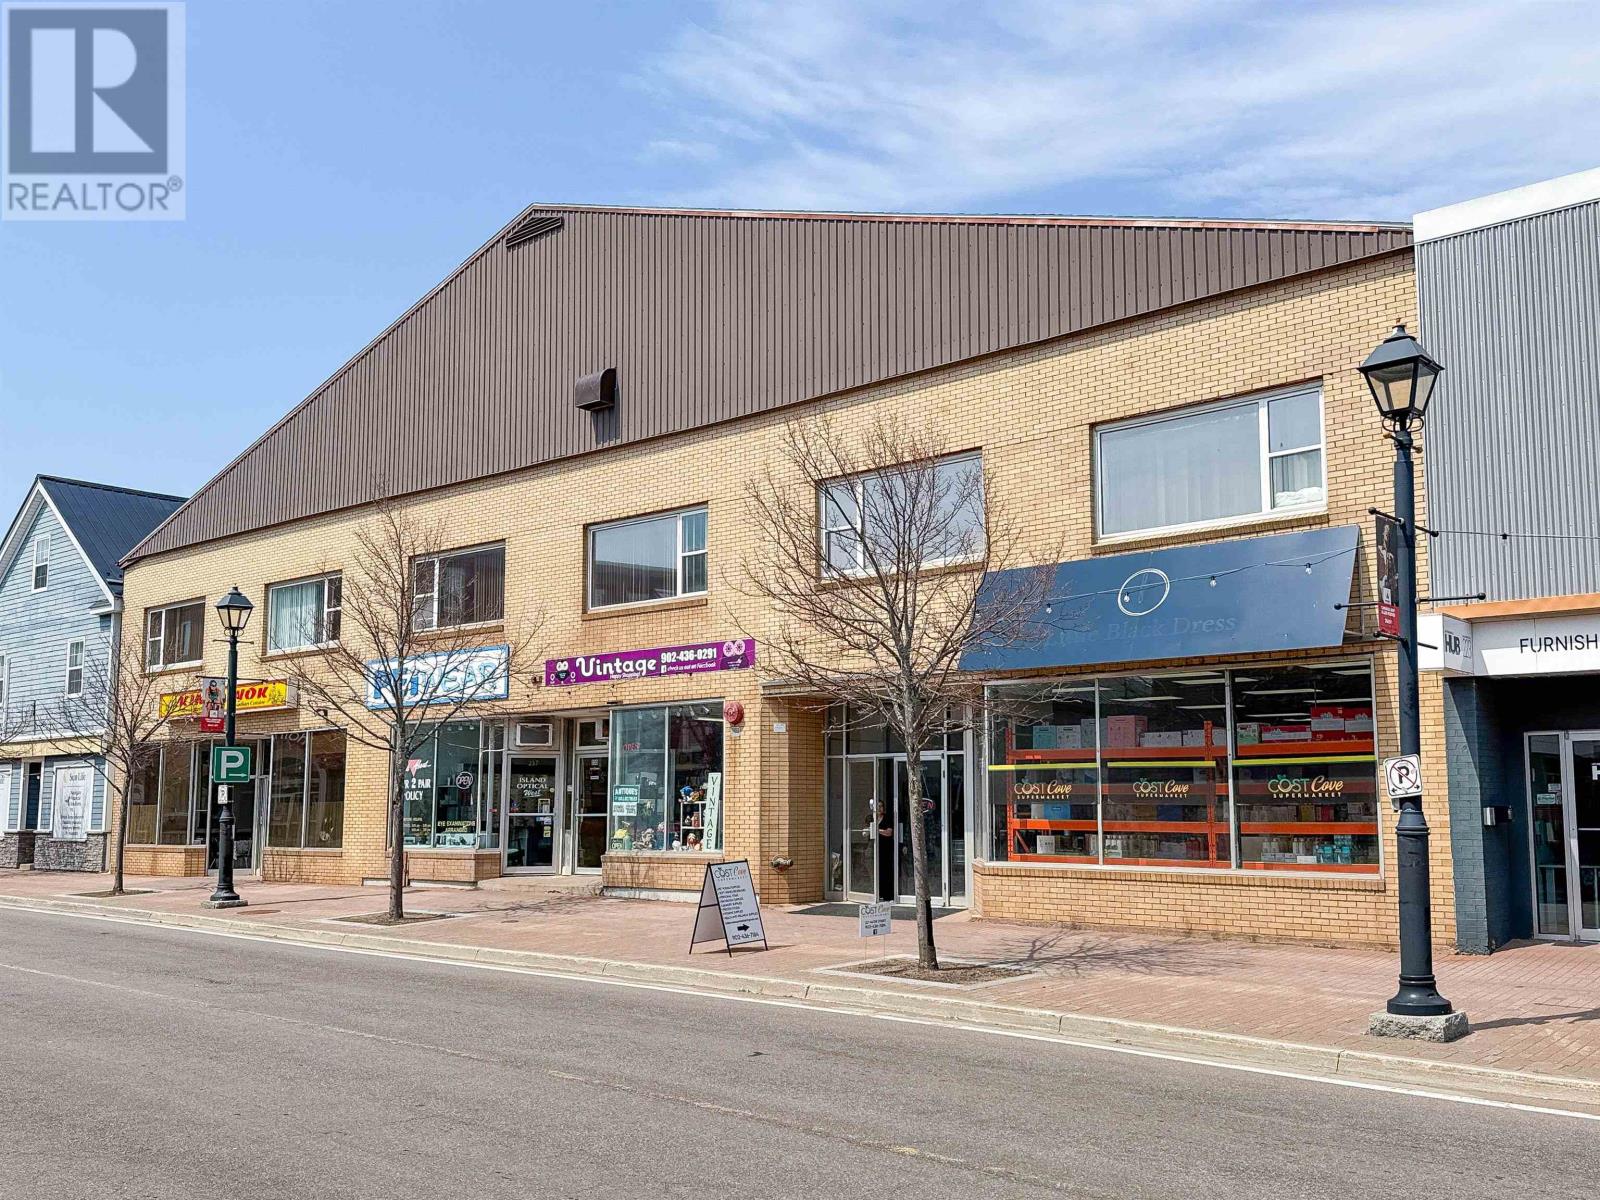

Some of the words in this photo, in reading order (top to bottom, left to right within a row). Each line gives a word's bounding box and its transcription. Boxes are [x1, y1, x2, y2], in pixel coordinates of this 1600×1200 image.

[1174, 616, 1237, 636] Dress
[1444, 633, 1461, 656] HUB
[1520, 633, 1598, 654] FURNISH
[660, 647, 717, 664] 902-436-0291
[221, 751, 244, 779] P
[411, 778, 416, 789] 2
[418, 778, 431, 789] PAIR
[1014, 781, 1045, 795] COST
[1047, 779, 1072, 795] Cove
[1132, 780, 1164, 794] COST
[1165, 779, 1189, 794] Cove
[1267, 778, 1310, 793] COST
[1311, 775, 1344, 792] Cove
[706, 775, 718, 850] VINTAGE
